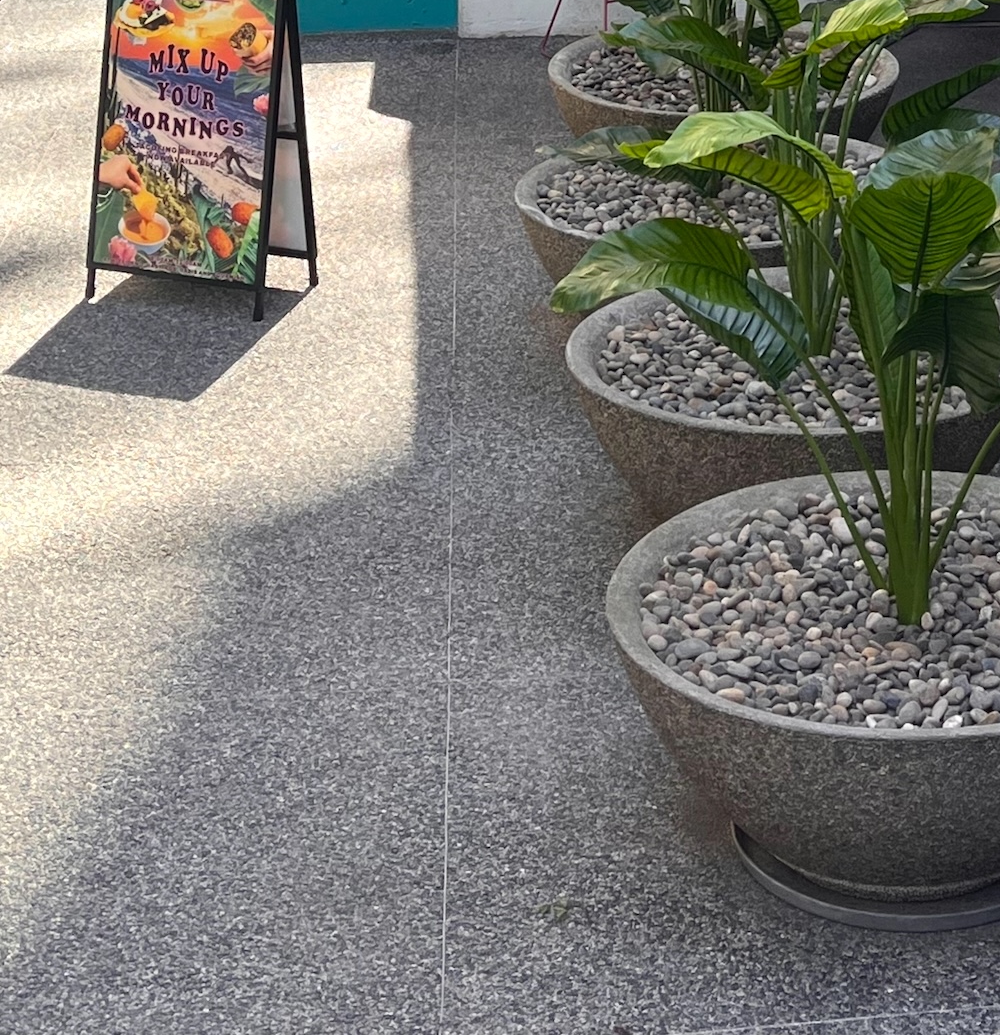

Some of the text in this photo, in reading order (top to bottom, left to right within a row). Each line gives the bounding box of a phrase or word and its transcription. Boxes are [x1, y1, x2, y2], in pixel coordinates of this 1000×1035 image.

[148, 44, 229, 82] MIX UP
[157, 82, 215, 111] YOUR
[125, 104, 245, 140] MORNINGS
[136, 143, 177, 154] ACOINO
